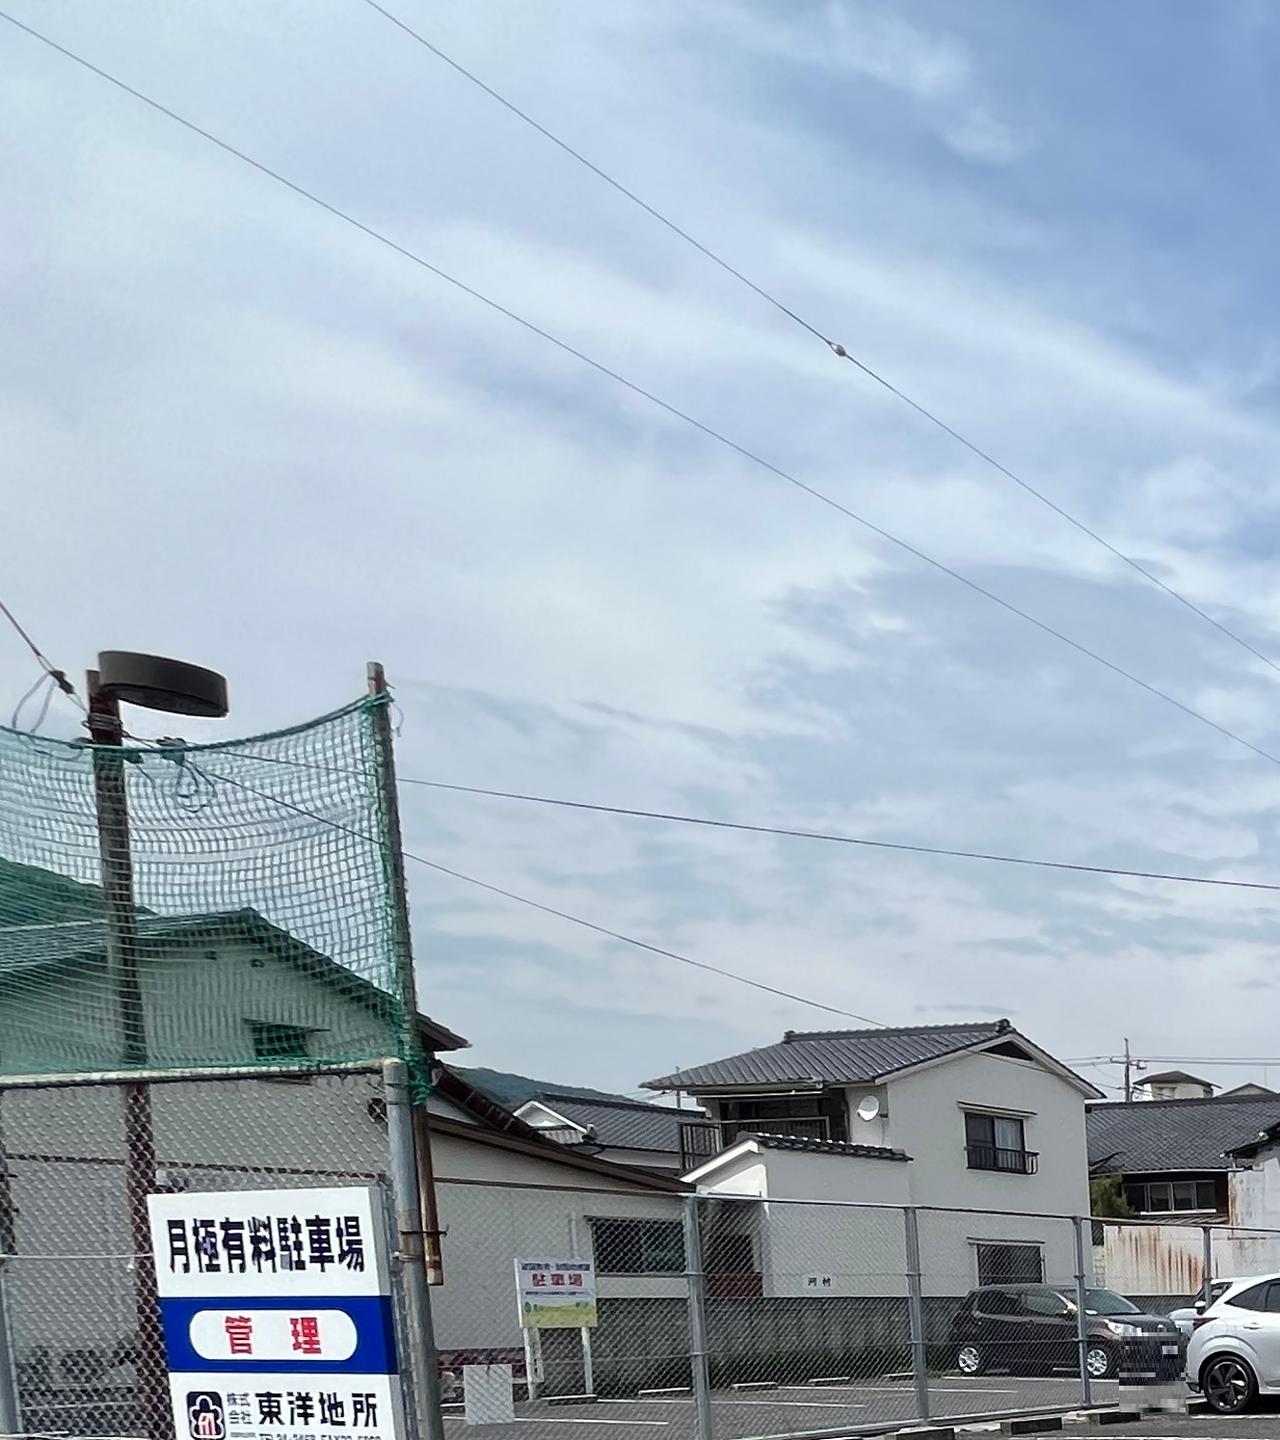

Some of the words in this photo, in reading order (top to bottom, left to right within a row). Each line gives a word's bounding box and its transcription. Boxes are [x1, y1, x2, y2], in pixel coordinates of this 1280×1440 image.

[166, 1214, 365, 1274] 月極有料駐車場
[224, 1315, 322, 1355] 管理
[255, 1391, 378, 1428] 東洋地所
